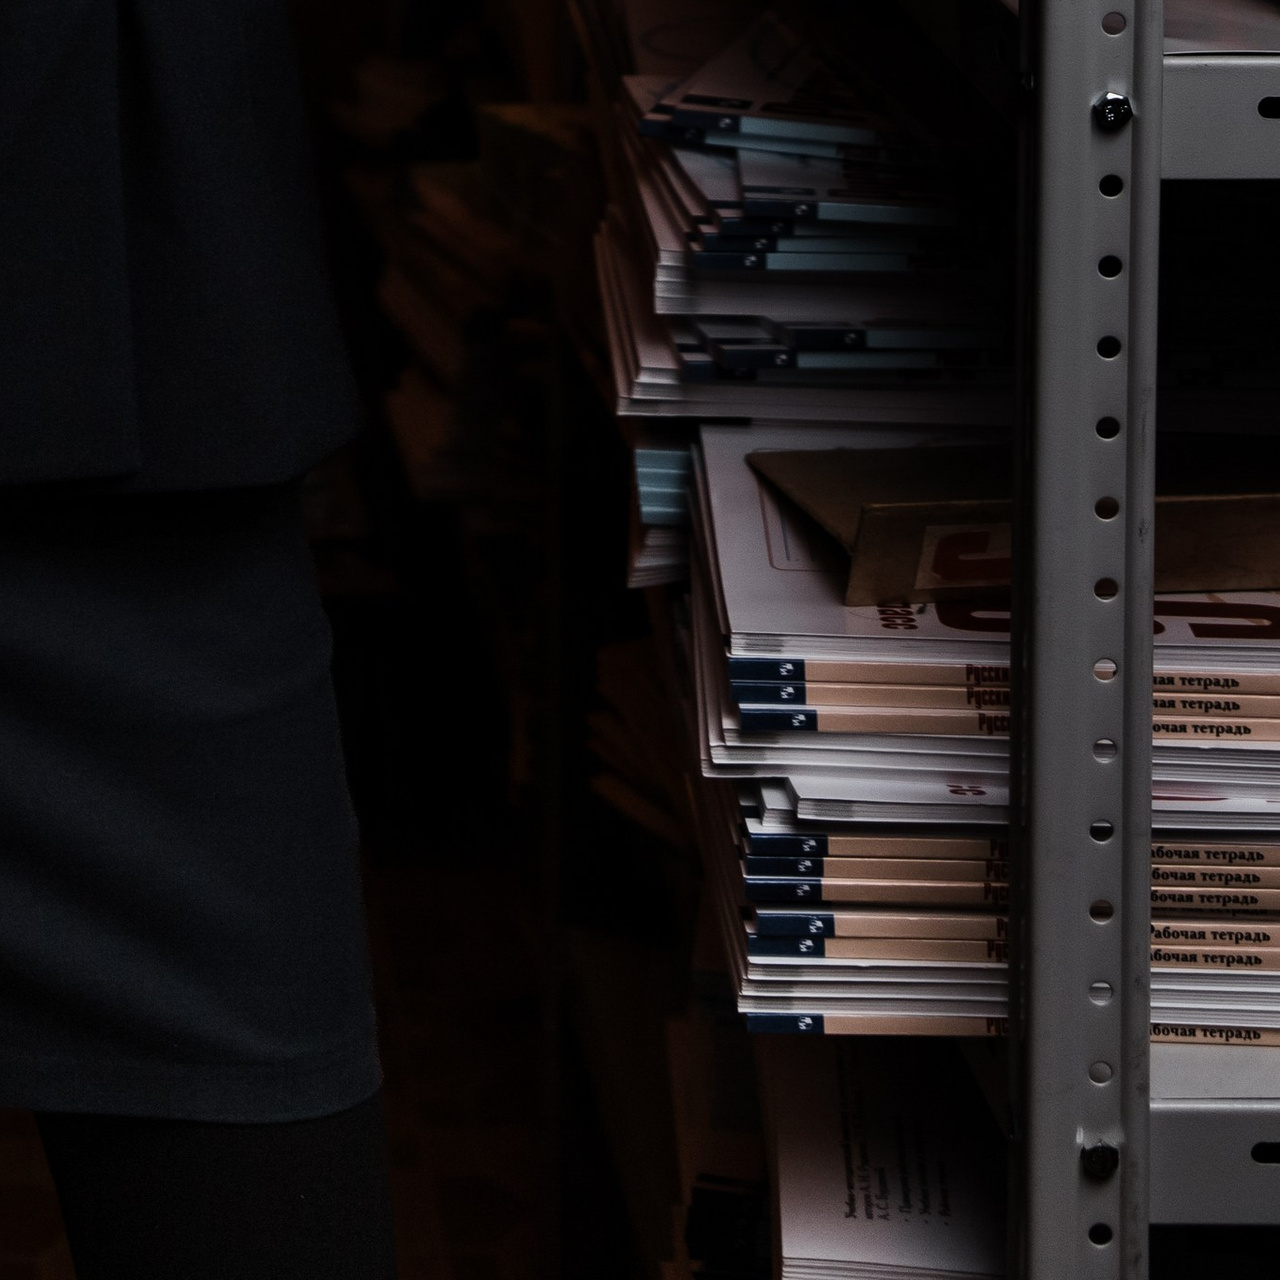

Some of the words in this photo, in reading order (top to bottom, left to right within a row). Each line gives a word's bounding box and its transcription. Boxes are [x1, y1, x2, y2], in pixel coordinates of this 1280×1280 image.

[1179, 677, 1240, 690] тетрадь
[1180, 699, 1241, 713] тетрадь
[1192, 724, 1252, 737] тетрадь
[1205, 850, 1265, 864] тетрадь
[1200, 872, 1261, 886] тетрадь
[1199, 894, 1259, 907] тетрадь
[1210, 929, 1271, 944] тетрадь
[1202, 953, 1263, 967] тетрадь
[1201, 1028, 1262, 1042] тетрадь
